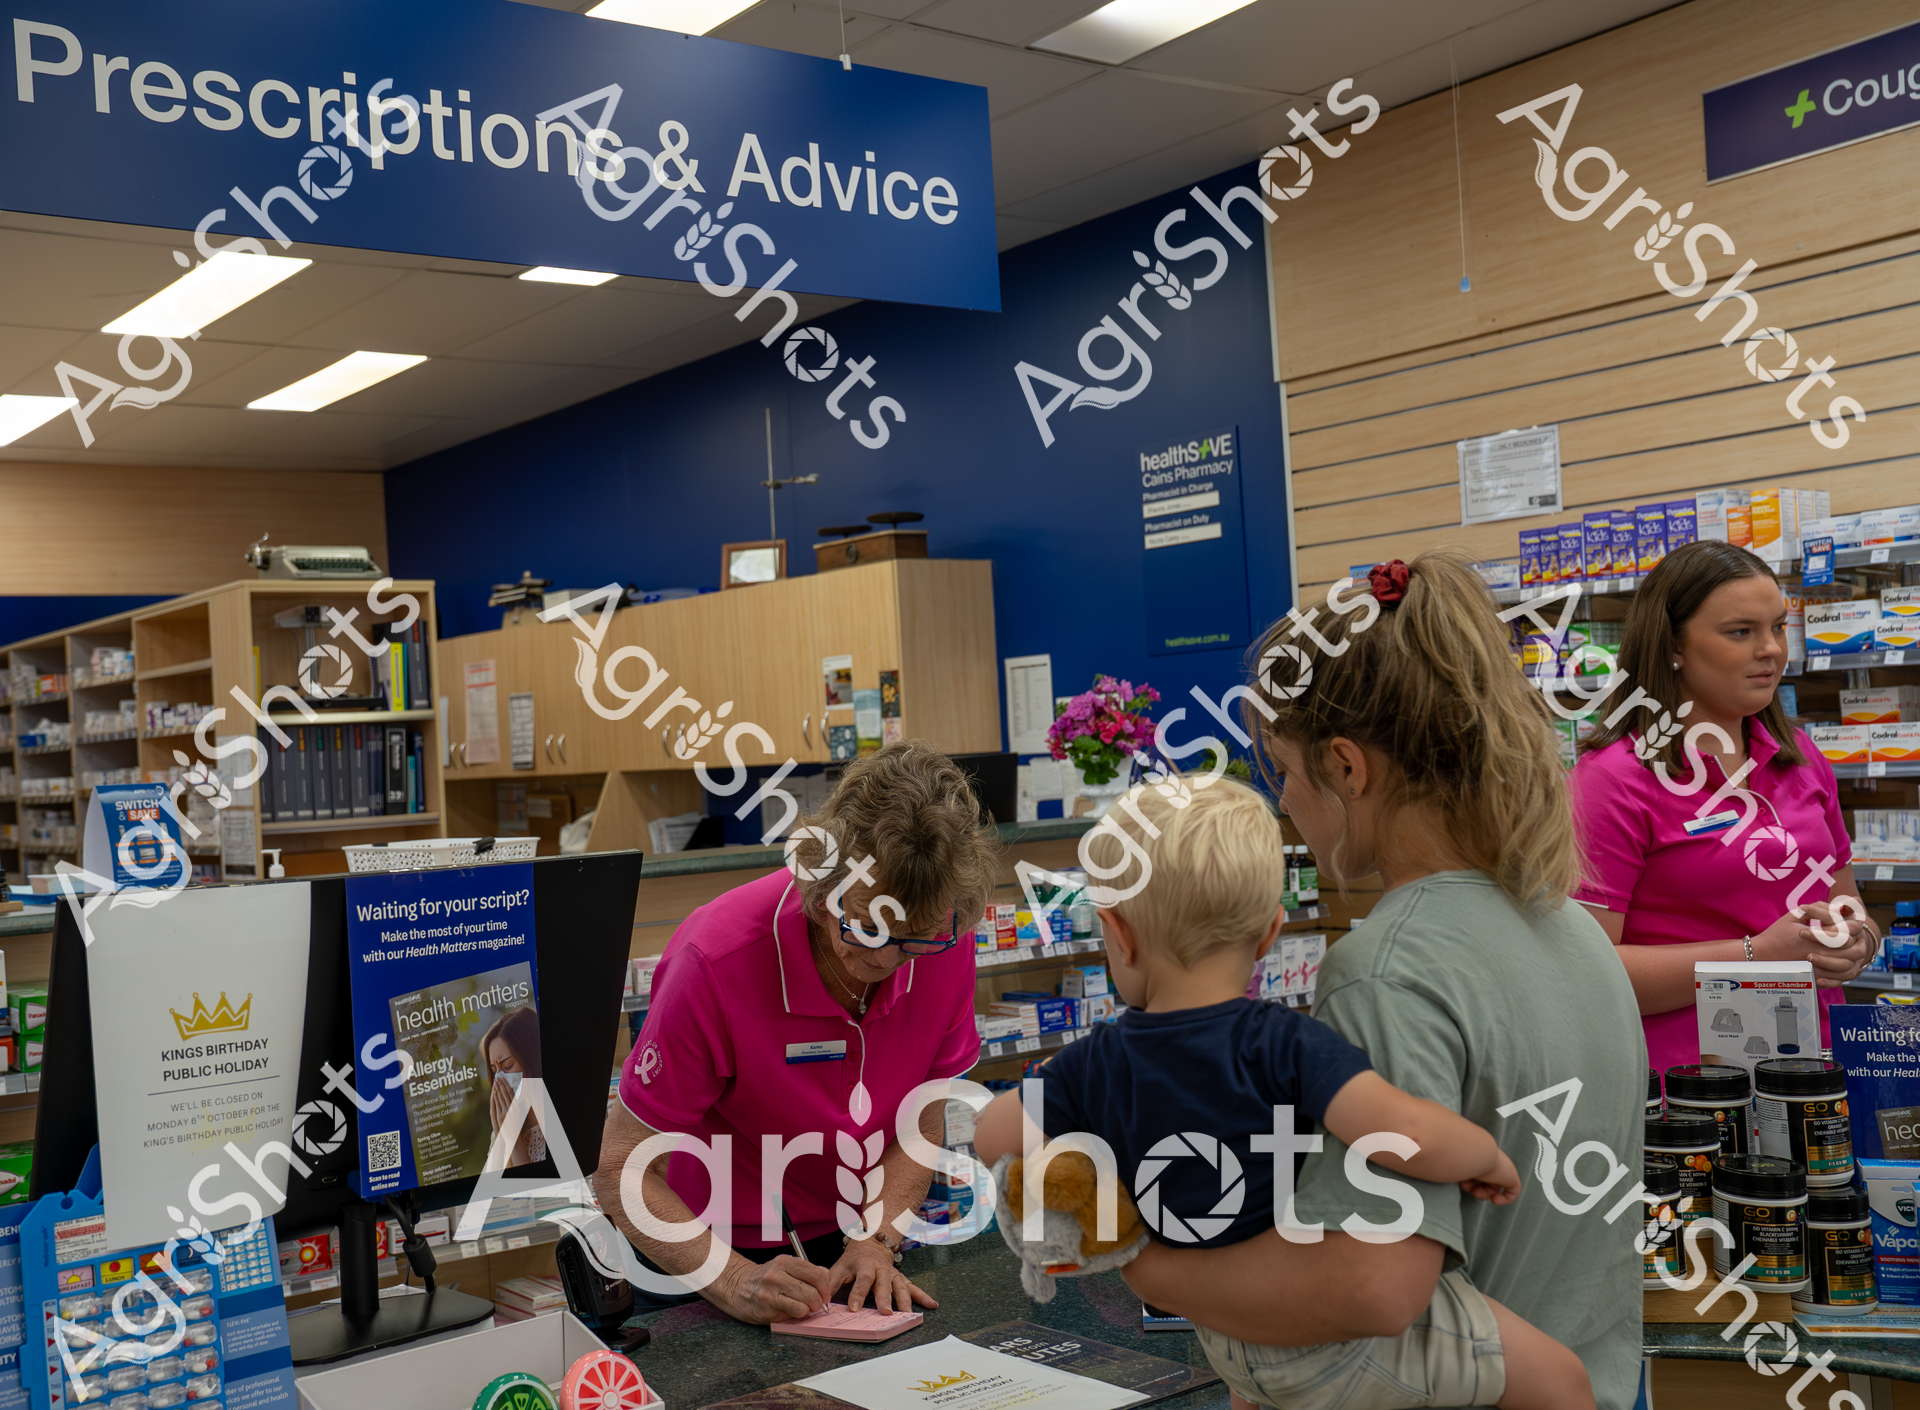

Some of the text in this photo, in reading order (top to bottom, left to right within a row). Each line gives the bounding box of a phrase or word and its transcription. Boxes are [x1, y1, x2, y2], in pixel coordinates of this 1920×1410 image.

[12, 18, 959, 225] Prescriptions & Advice
[1142, 459, 1233, 488] Cains Pharmacy
[1142, 487, 1180, 502] Pharmacist
[1188, 482, 1214, 492] Charge
[1145, 514, 1209, 532] Pharmacist on Duty
[1804, 538, 1832, 549] SWITCH
[1812, 544, 1832, 553] SAVE
[1884, 594, 1910, 603] Codral
[1808, 612, 1840, 624] Codral
[1877, 625, 1903, 633] Codral
[1843, 696, 1868, 705] Codral
[1872, 731, 1897, 739] Codral
[115, 799, 160, 811] SWITCH
[119, 809, 158, 821] & SAVE
[356, 889, 530, 922] Waiting for your script?
[381, 920, 508, 943] Make the most of your time
[363, 934, 525, 963] with our Health Matters magazine!
[396, 981, 529, 1033] health matters
[505, 997, 529, 1009] magazine
[1840, 1027, 1906, 1046] Waiting
[161, 1038, 269, 1062] KINGS BIRTHDAY
[1866, 1052, 1916, 1062] Make the
[163, 1057, 269, 1082] PUBLIC HOLIDAY
[407, 1055, 454, 1080] Allergy
[1847, 1067, 1870, 1077] with
[408, 1065, 478, 1097] Essentials:
[170, 1092, 263, 1112] WE'LL BE CLOSED ON
[412, 1092, 448, 1110] Must-Know Tips
[1804, 1102, 1828, 1112] GO
[148, 1118, 189, 1132] MONDAY
[207, 1109, 248, 1122] OCTOBER
[250, 1105, 266, 1115] FOR
[267, 1103, 280, 1112] THE
[419, 1111, 441, 1122] Medicine
[144, 1117, 284, 1148] KING'S BIRTHDAY PUBLIC HOLIDAY
[417, 1134, 430, 1143] Spring
[369, 1175, 382, 1183] Scan
[388, 1171, 400, 1180] read
[371, 1183, 388, 1191] online
[1744, 1206, 1770, 1218] GO
[1825, 1231, 1850, 1241] GO
[1017, 1342, 1049, 1351] from
[245, 1376, 280, 1392] professional
[922, 1375, 1002, 1402] KINGS BIRTHDAY
[251, 1389, 265, 1398] offer
[270, 1392, 288, 1401] health
[933, 1378, 1014, 1404] PUBLIC HOLIDAY
